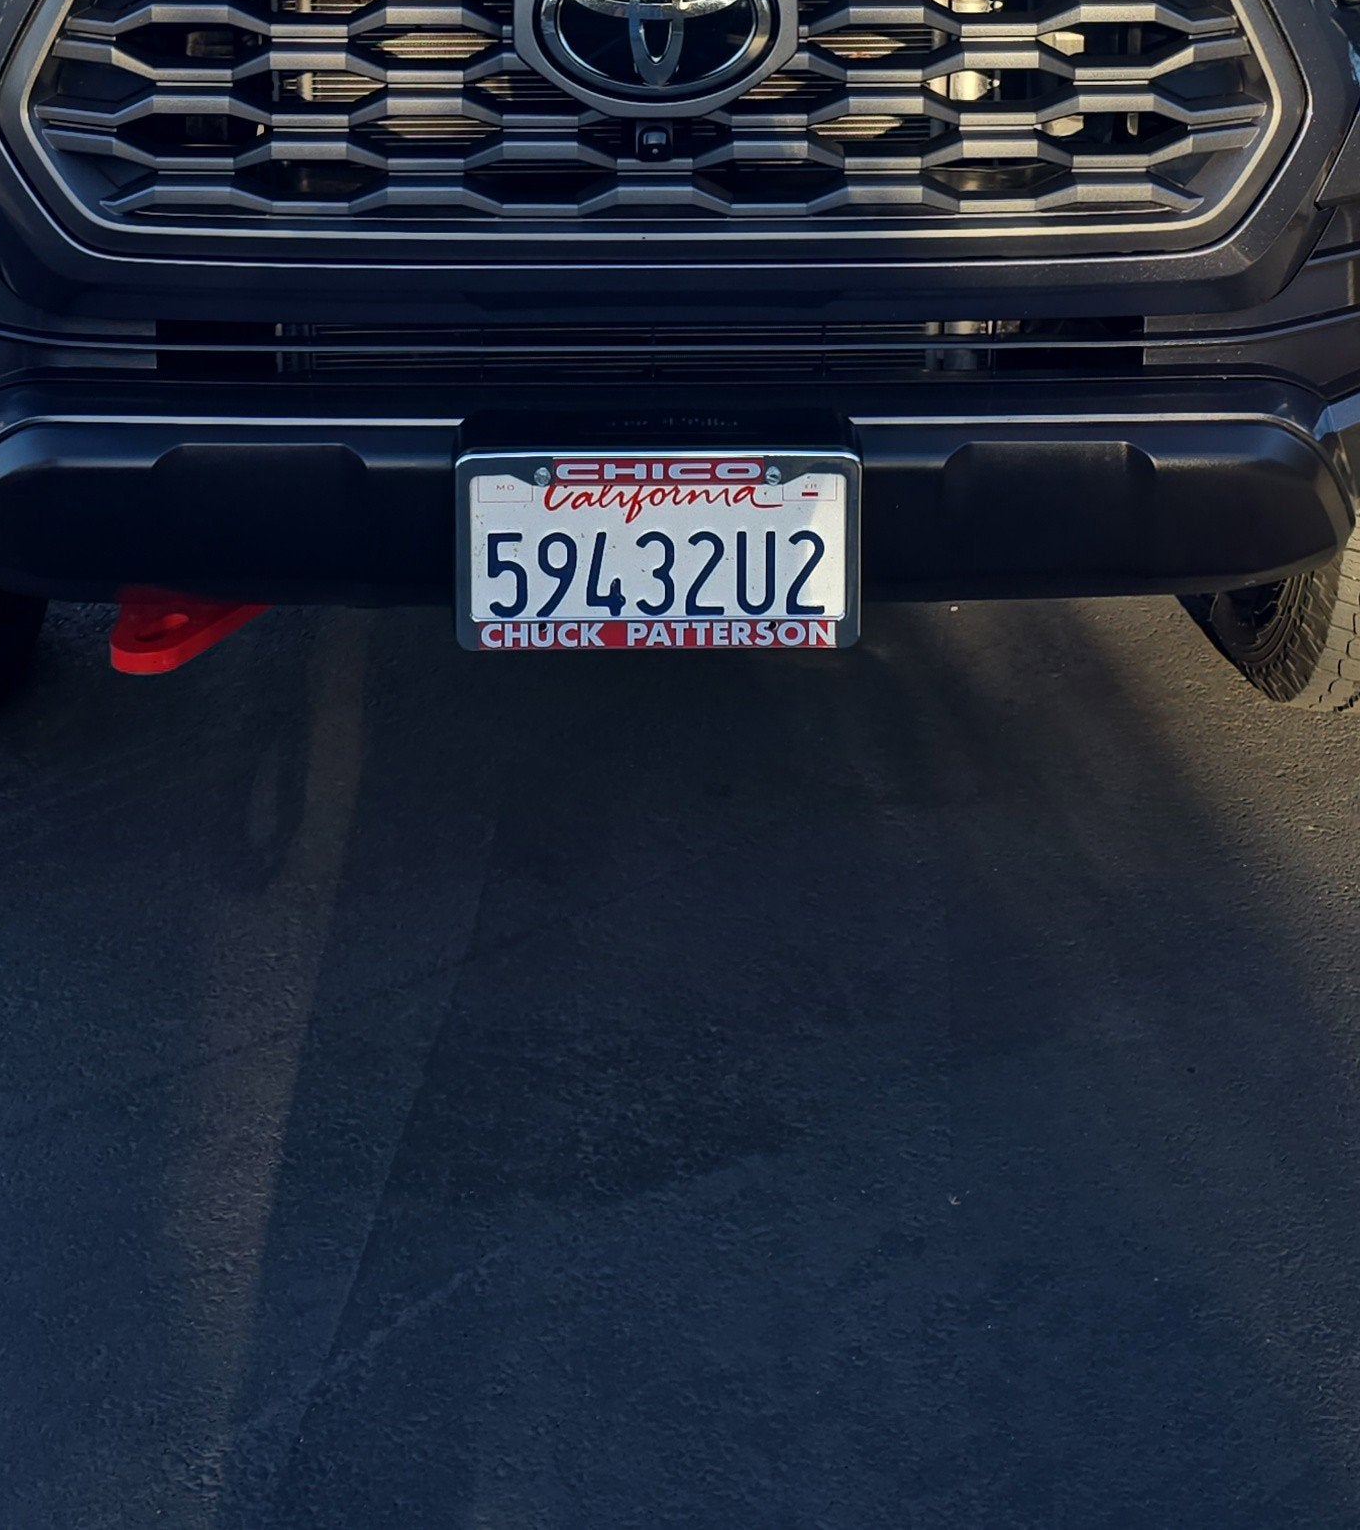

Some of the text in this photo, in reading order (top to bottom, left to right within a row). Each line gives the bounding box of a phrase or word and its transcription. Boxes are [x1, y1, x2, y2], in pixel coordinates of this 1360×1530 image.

[555, 463, 761, 480] CHICO
[544, 484, 783, 523] California
[487, 530, 826, 618] 59432U2
[480, 622, 837, 648] CHUCK PATTERSON
